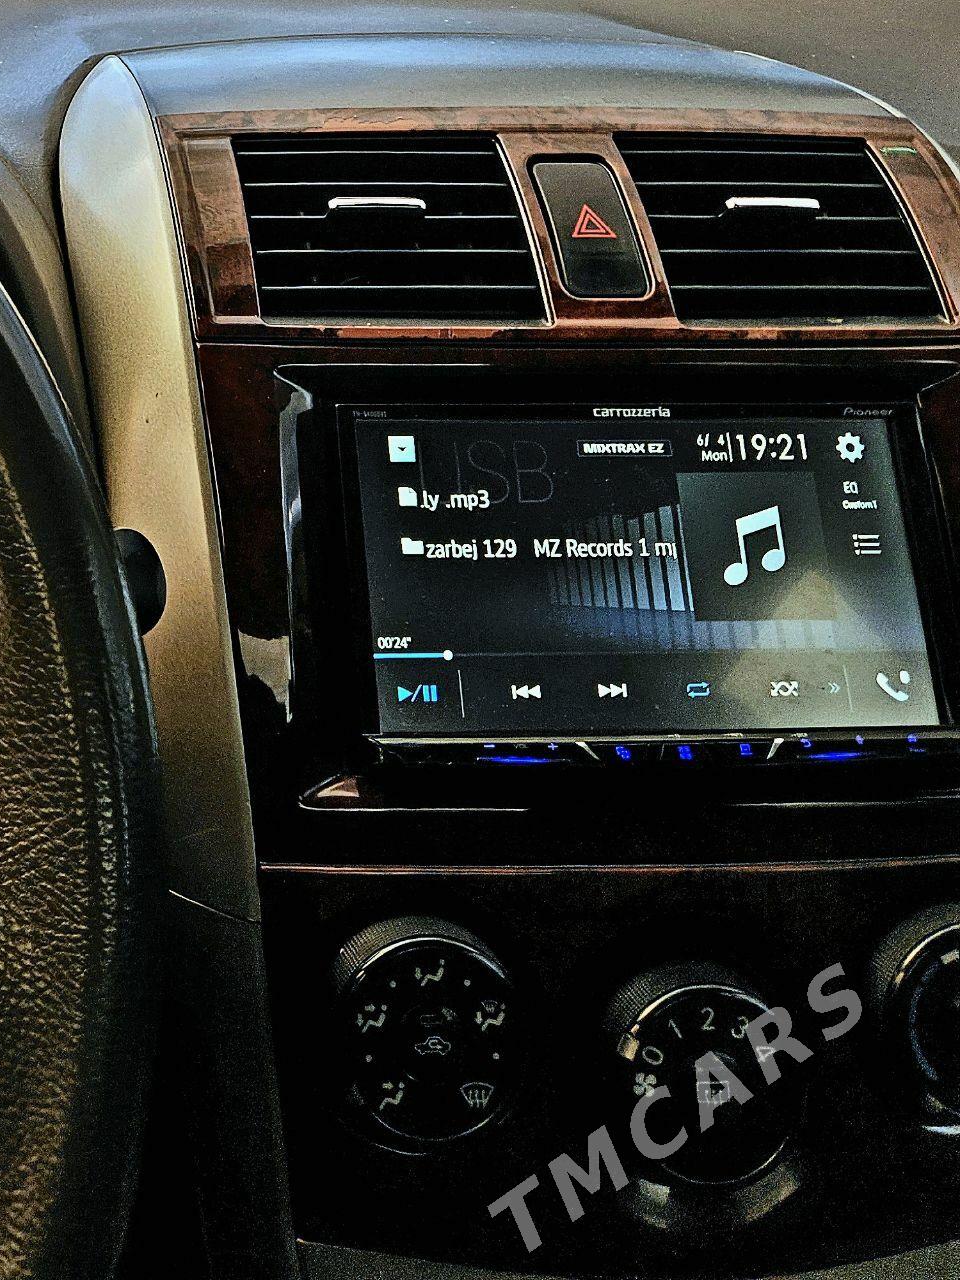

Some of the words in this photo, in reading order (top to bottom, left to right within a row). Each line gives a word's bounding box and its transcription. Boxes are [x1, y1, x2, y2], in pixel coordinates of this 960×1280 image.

[592, 406, 671, 418] carrozzeria
[843, 407, 894, 417] Pioneer
[583, 442, 646, 454] MIXTRAX
[647, 442, 665, 454] EZ
[701, 450, 728, 463] Mon
[735, 433, 808, 461] 19:21
[445, 489, 491, 511] .mp3
[426, 539, 479, 561] zarbej
[484, 539, 518, 558] 129
[534, 539, 562, 558] MZ
[566, 538, 634, 558] Records
[639, 538, 651, 557] 1
[668, 1019, 683, 1039] 1
[701, 1007, 716, 1031] 2
[731, 1016, 750, 1039] 3
[642, 1046, 664, 1065] 0
